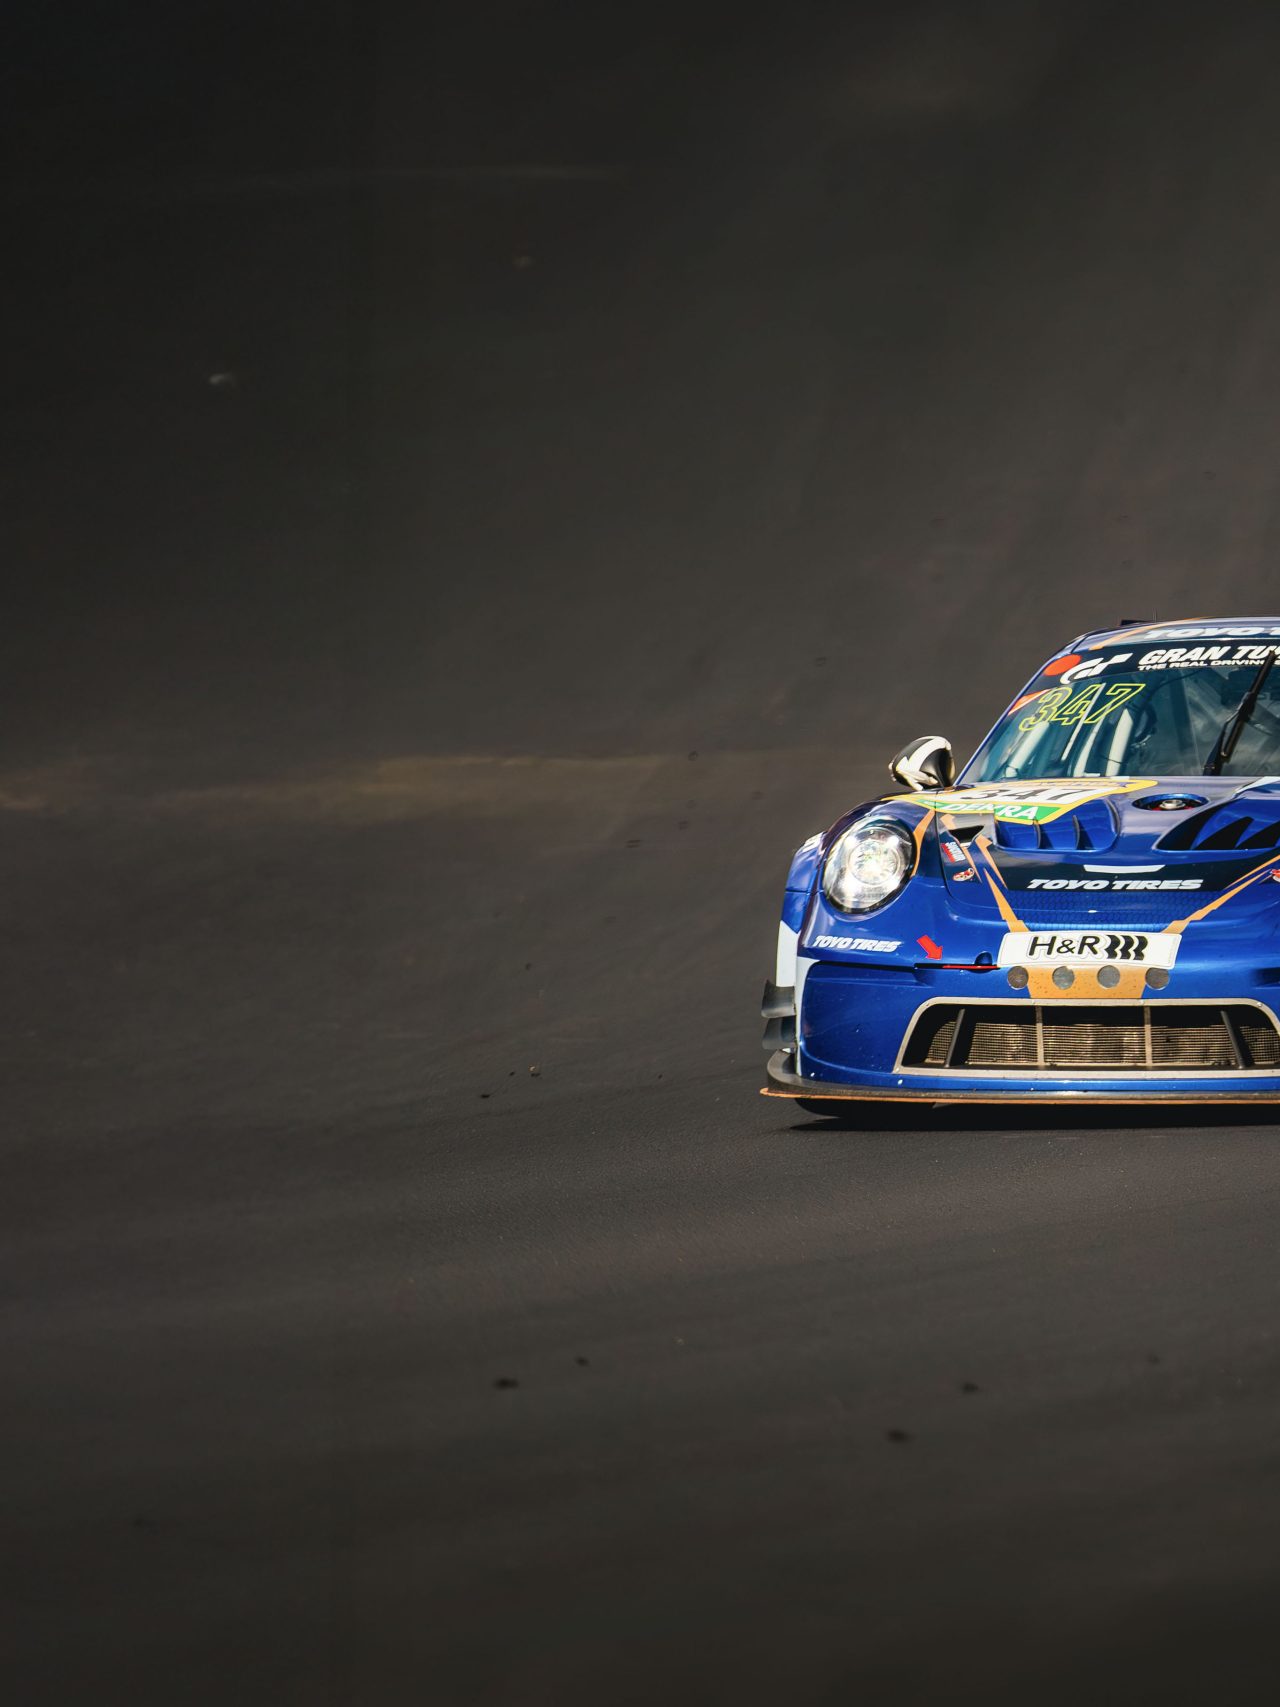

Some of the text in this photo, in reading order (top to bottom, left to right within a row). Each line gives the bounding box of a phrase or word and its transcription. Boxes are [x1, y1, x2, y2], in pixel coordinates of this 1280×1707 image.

[1143, 627, 1264, 639] TOYO
[1138, 646, 1232, 665] GRAN
[1138, 664, 1167, 672] THE
[1169, 660, 1208, 669] REAL
[1018, 683, 1146, 732] 347
[960, 788, 1092, 801] 347
[940, 803, 1039, 820] DEKRA
[1026, 879, 1204, 891] TOYO TIRES
[812, 935, 902, 953] TOYO TIRES
[1028, 935, 1101, 957] H&R
